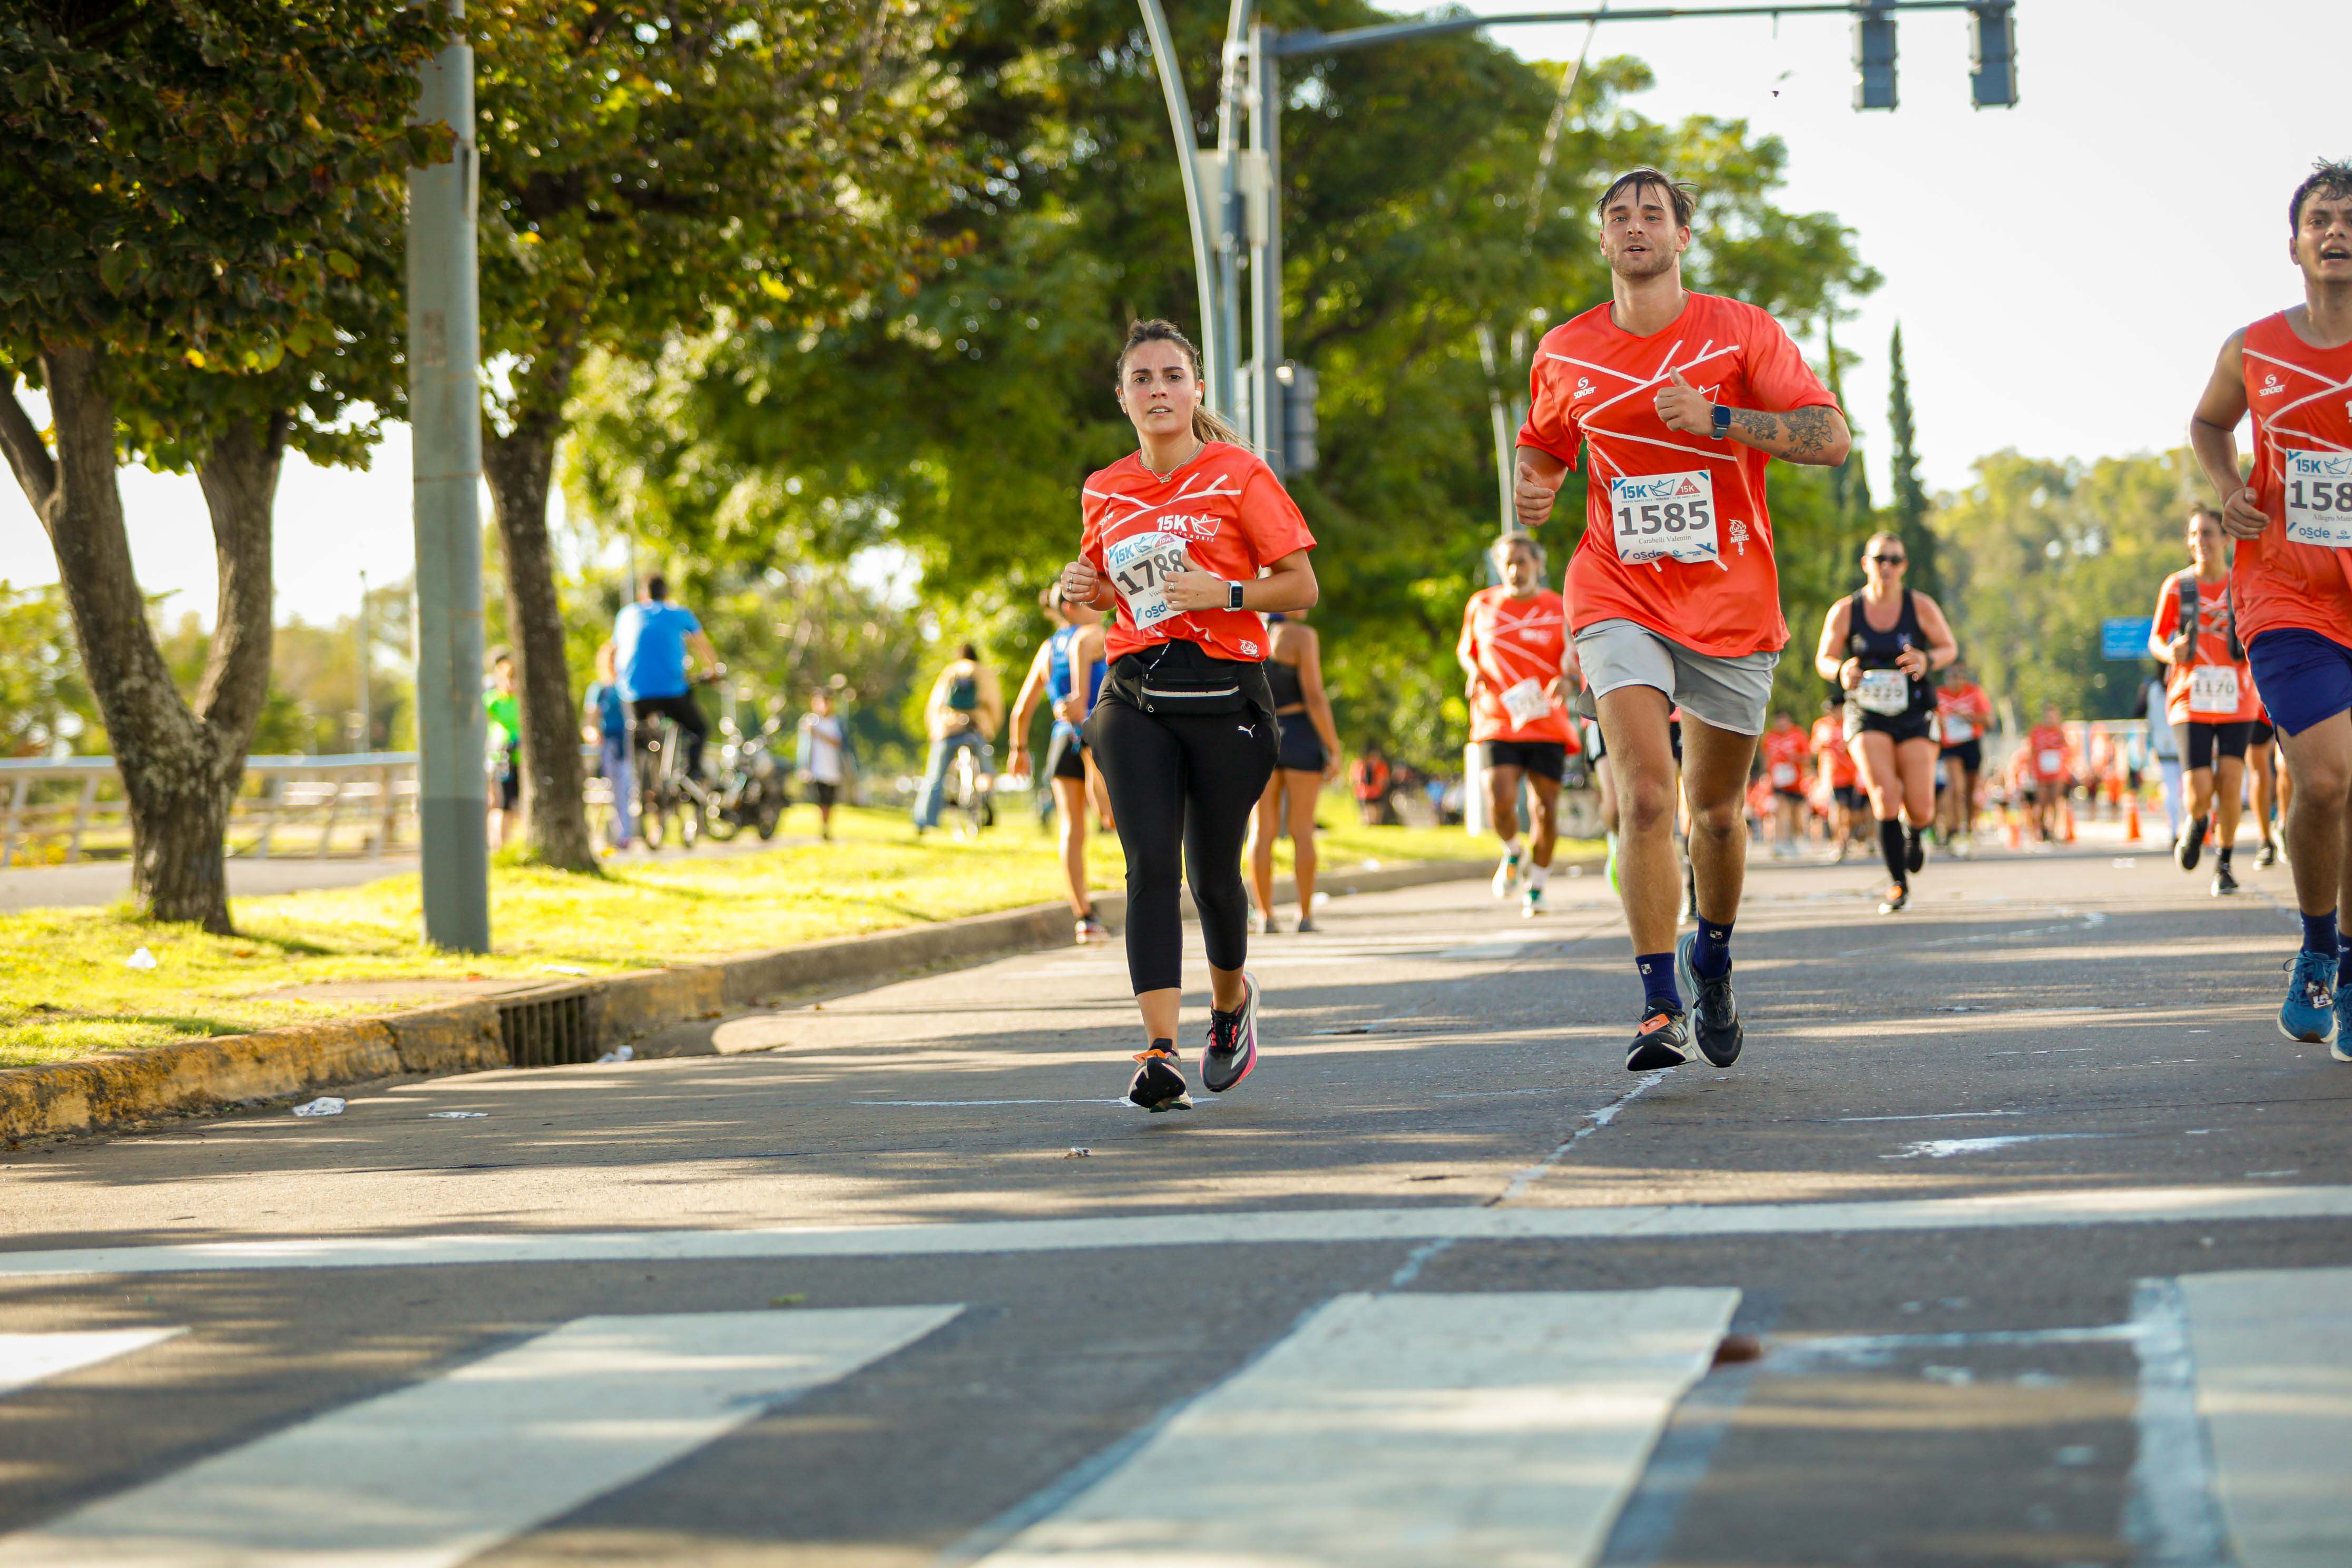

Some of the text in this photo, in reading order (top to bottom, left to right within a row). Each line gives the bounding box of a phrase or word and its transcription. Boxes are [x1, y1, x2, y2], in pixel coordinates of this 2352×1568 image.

[2295, 458, 2321, 473] 15K
[1621, 485, 1648, 499] 15K
[1157, 514, 1189, 532] 15K
[1618, 500, 1710, 536] 1585
[1730, 534, 1750, 544] ARDEC
[2299, 527, 2330, 539] osde
[1114, 544, 1135, 564] 15K
[1145, 600, 1168, 618] osd
